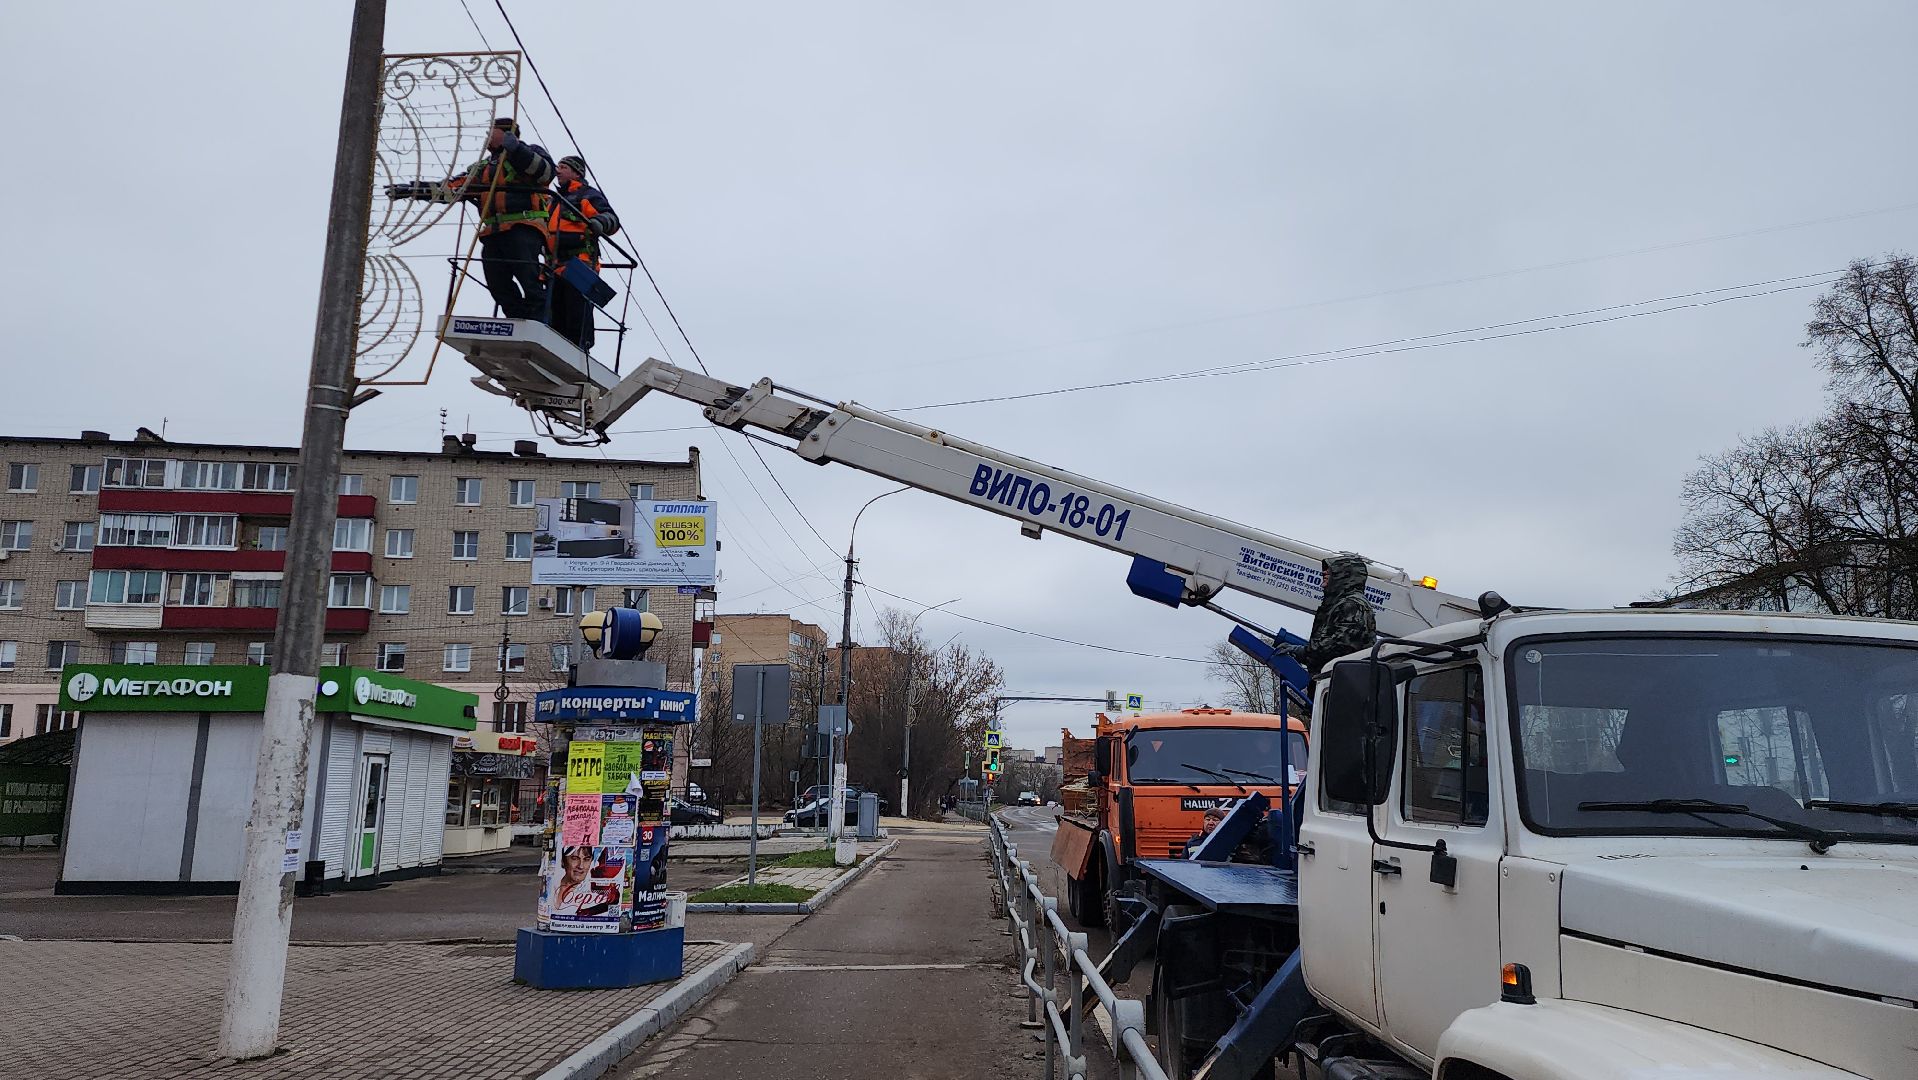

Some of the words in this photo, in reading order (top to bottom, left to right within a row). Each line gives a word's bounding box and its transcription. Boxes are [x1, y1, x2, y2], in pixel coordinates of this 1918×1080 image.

[969, 463, 1131, 542] ВИПО-18-01
[653, 504, 709, 514] СТОЛПЛИТ
[659, 521, 700, 529] КЕШБЭК
[569, 757, 602, 777] РЕТРО
[642, 830, 653, 841] 30
